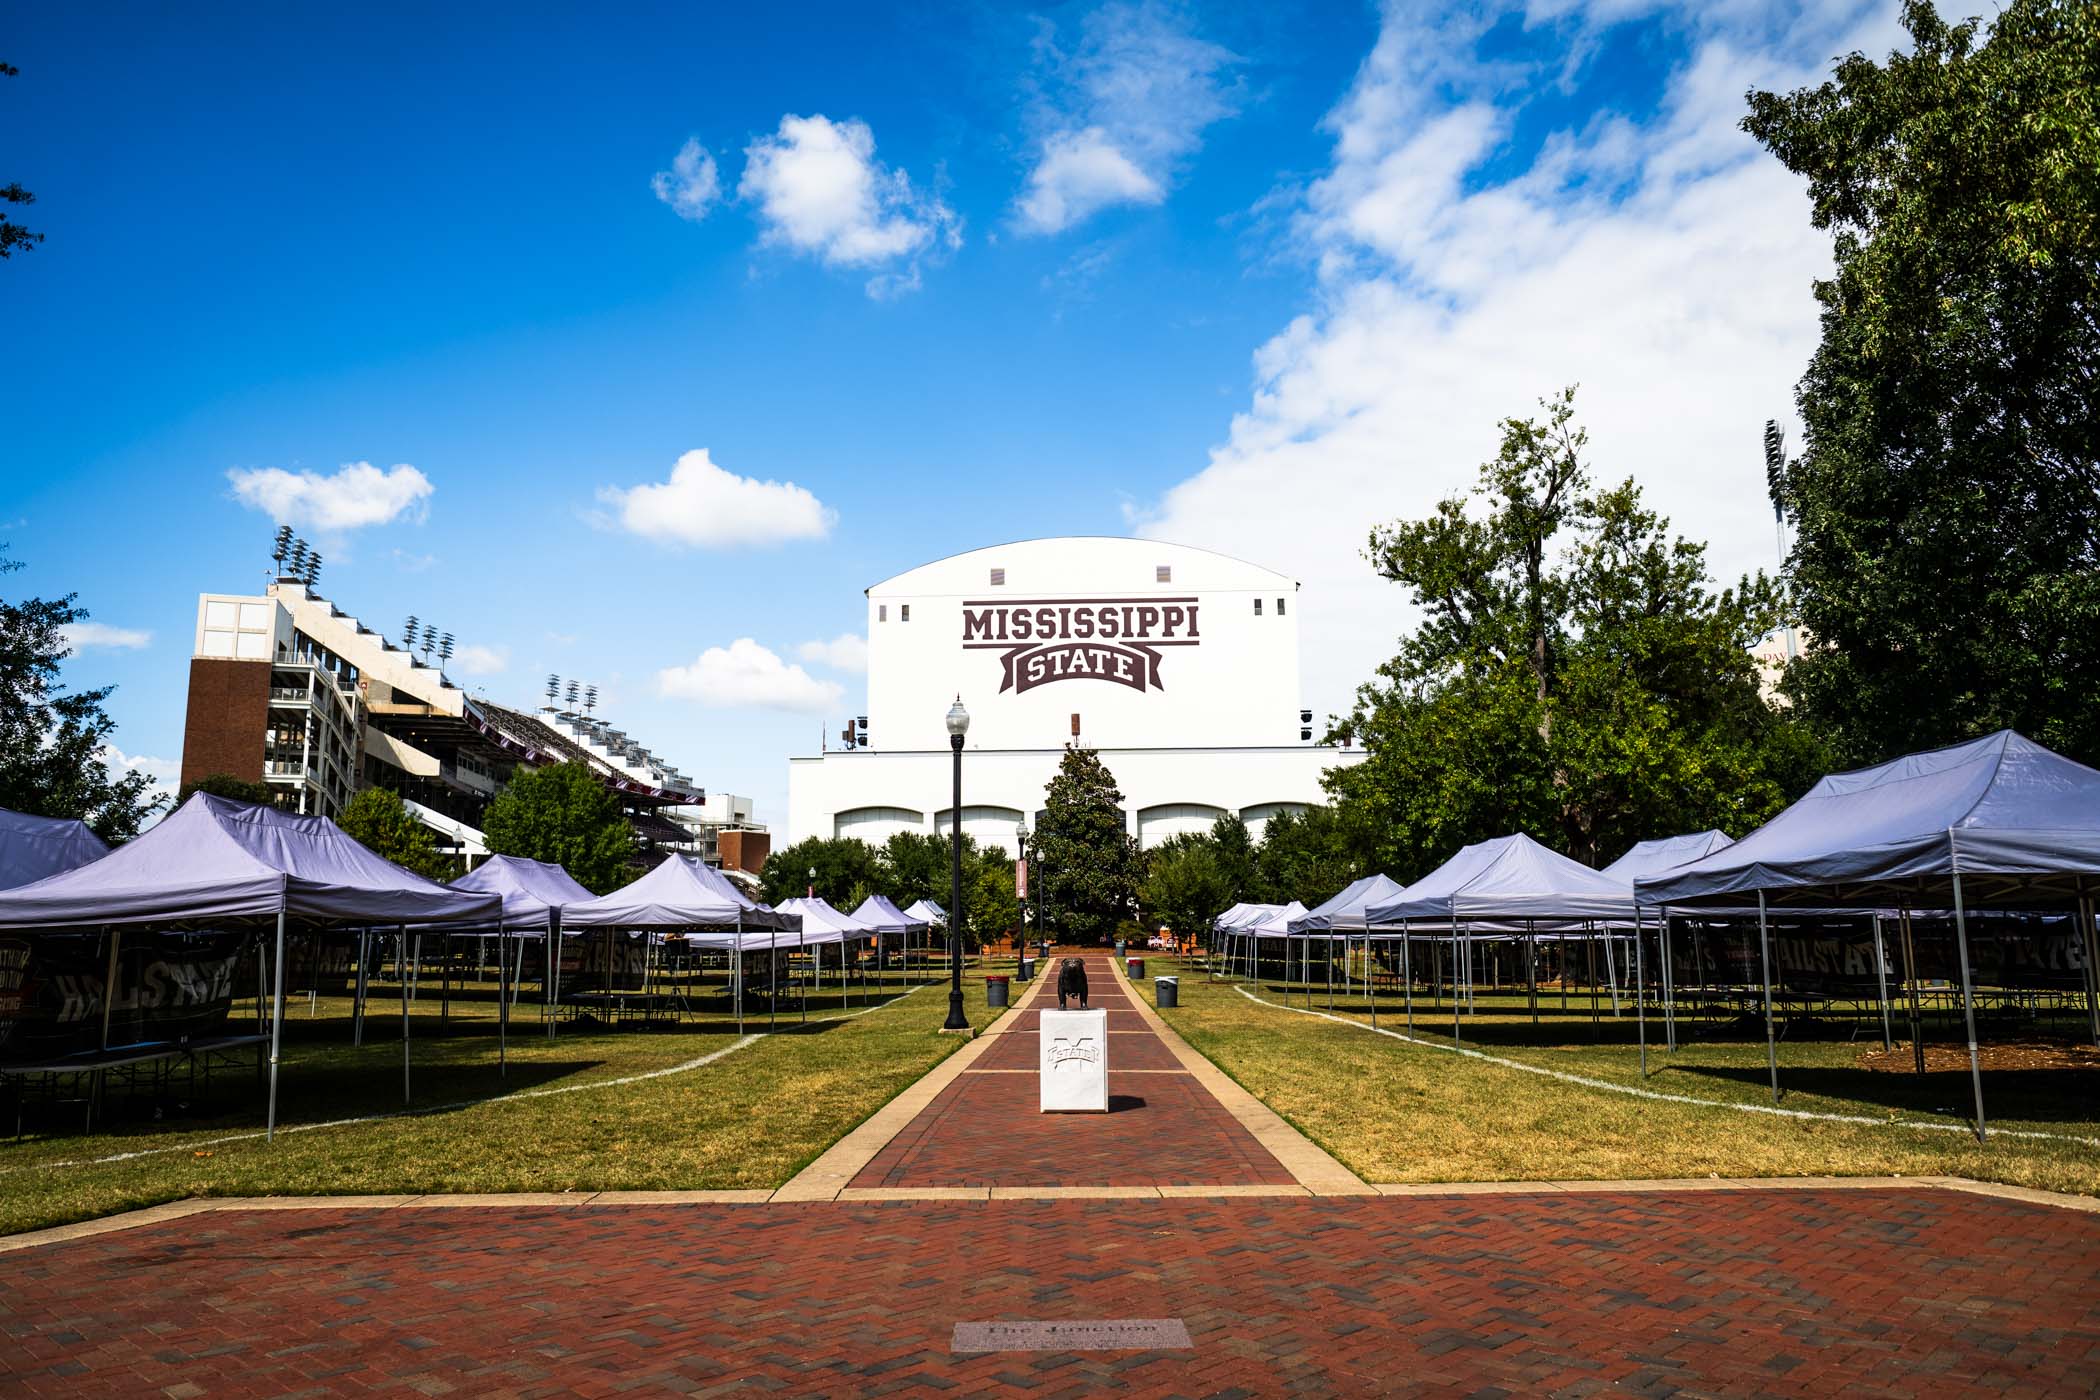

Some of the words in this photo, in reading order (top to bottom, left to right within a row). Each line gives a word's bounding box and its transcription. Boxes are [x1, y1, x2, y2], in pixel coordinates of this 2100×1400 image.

[962, 605, 1200, 641] MISSISSIPPI
[1027, 648, 1134, 682] STATE
[984, 1325, 1034, 1335] The
[1043, 1323, 1160, 1335] Junction
